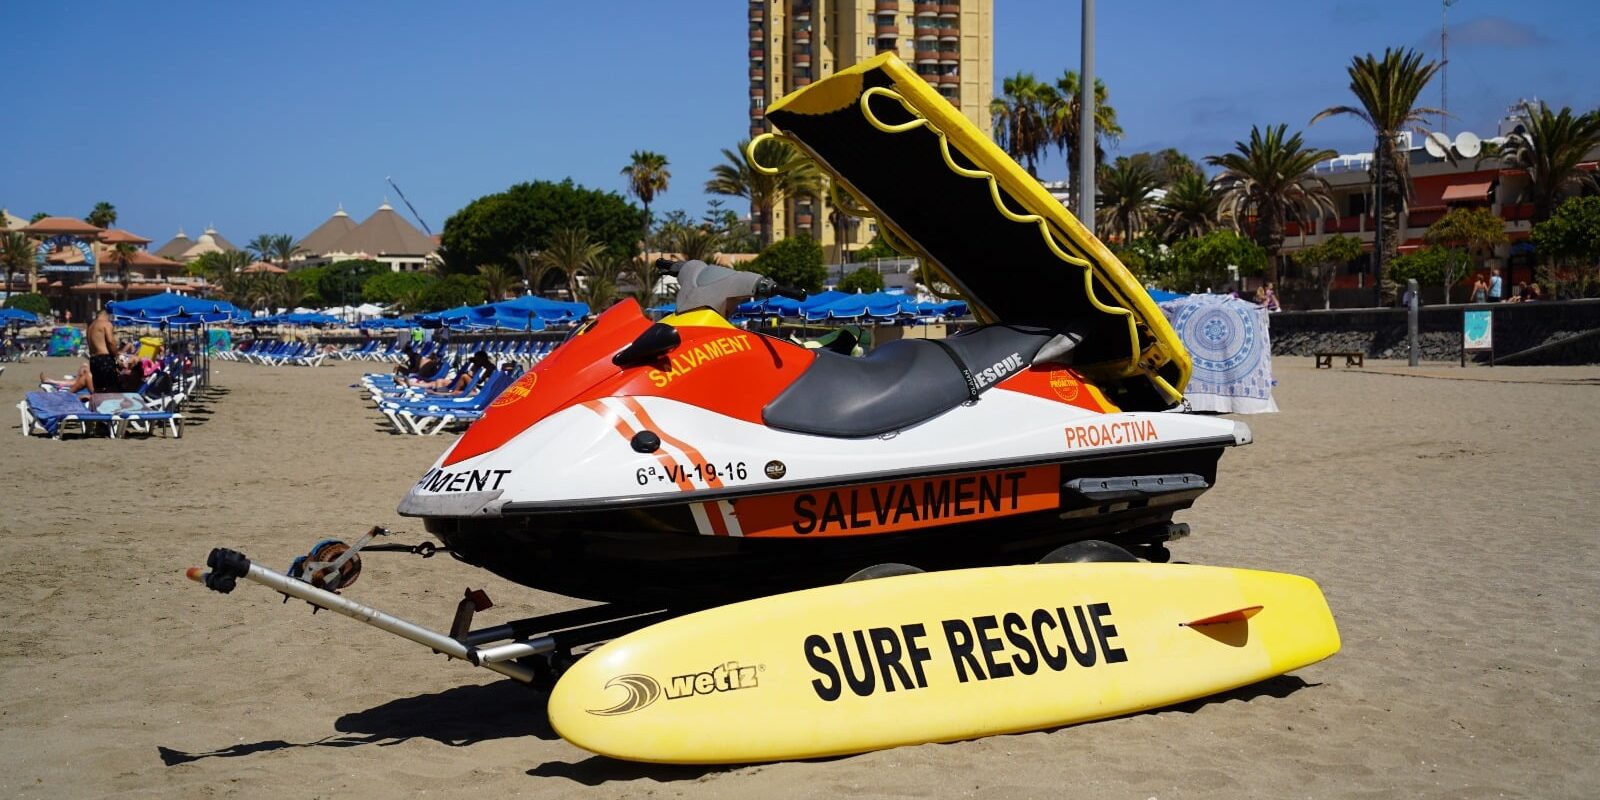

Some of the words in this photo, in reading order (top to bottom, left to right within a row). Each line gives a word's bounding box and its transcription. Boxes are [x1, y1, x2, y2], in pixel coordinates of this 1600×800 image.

[648, 334, 752, 388] SALVAMENT
[972, 352, 1024, 390] ESCUE
[1064, 419, 1158, 449] PROACTIVA
[792, 470, 1027, 535] SALVAMENT
[803, 622, 932, 702] SURF
[941, 602, 1129, 683] RESCUE
